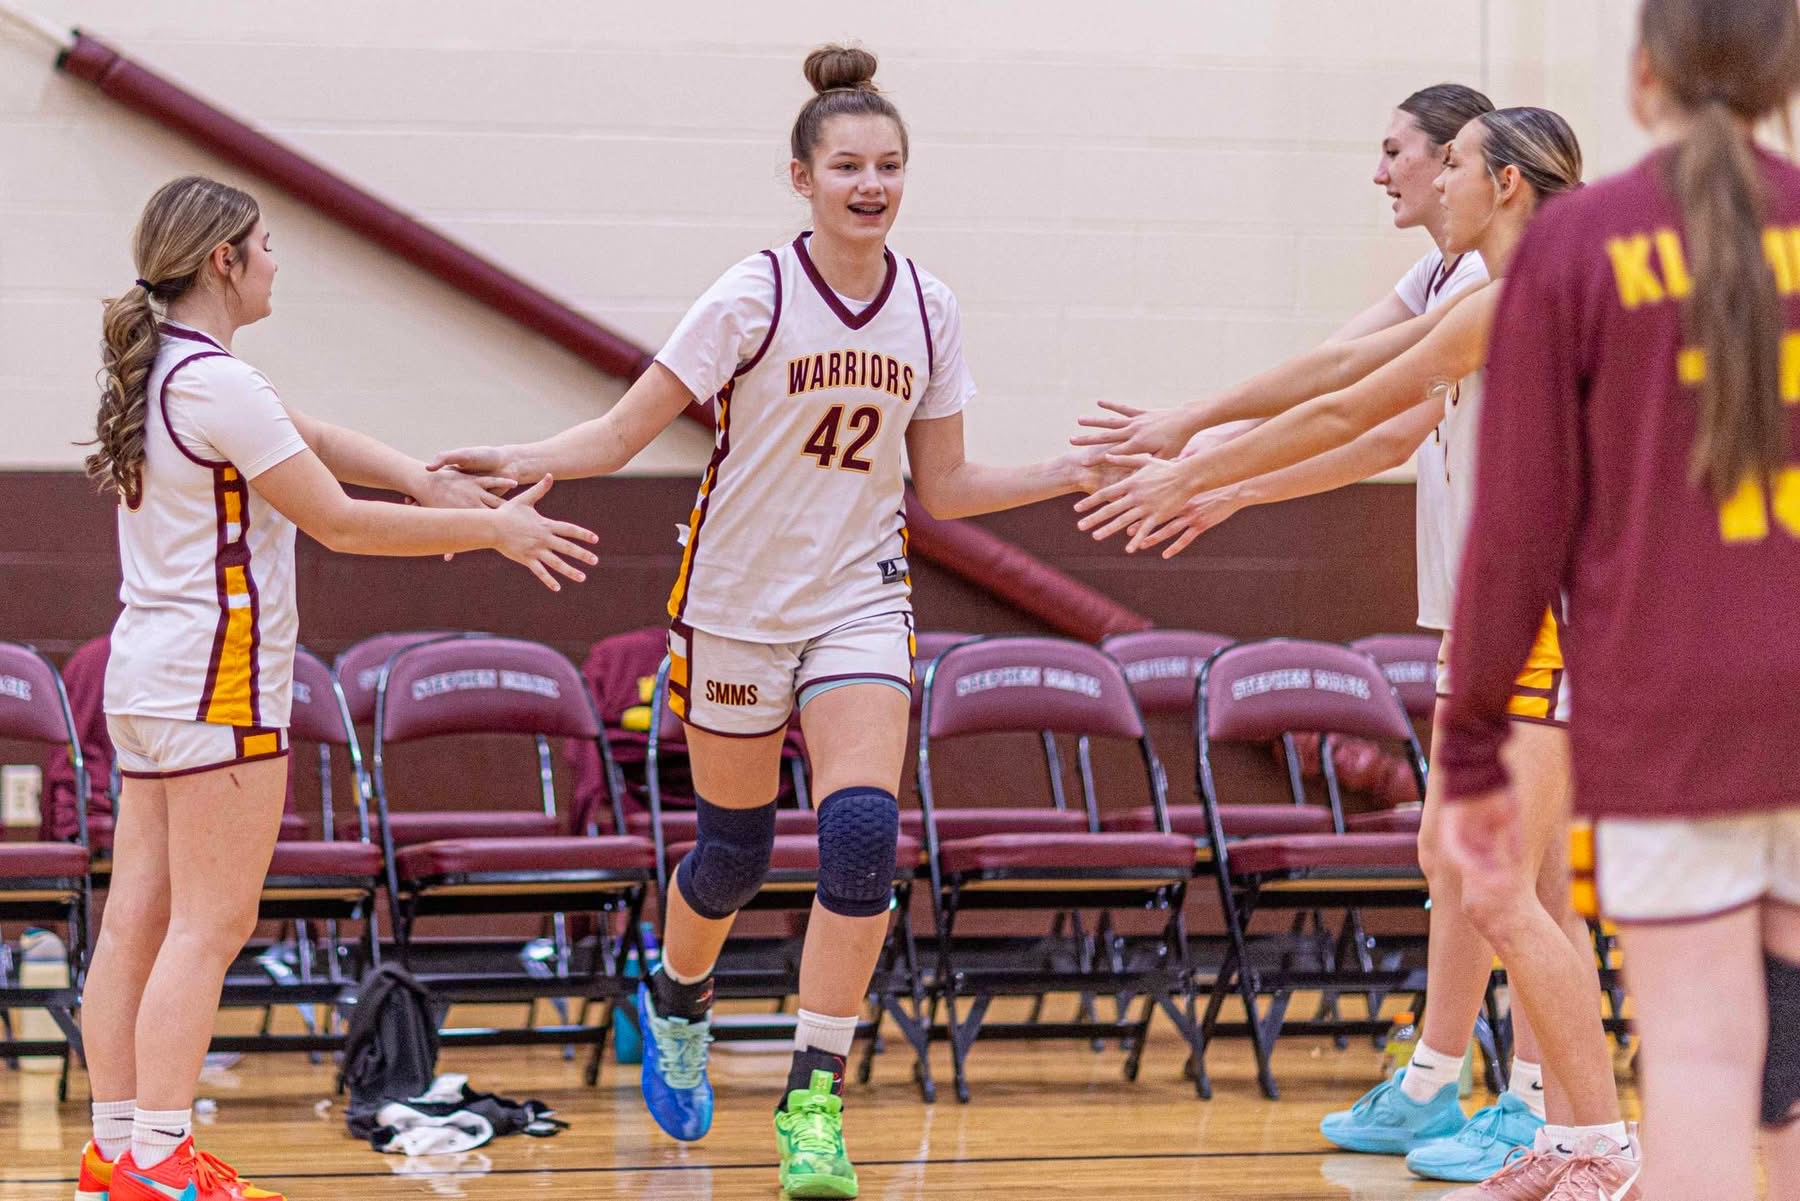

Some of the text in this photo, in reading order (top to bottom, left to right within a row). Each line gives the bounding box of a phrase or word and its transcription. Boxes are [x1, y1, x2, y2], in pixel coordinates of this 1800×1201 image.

[788, 350, 914, 403] WARRIORS
[801, 404, 882, 474] 42
[706, 680, 758, 705] SMMS
